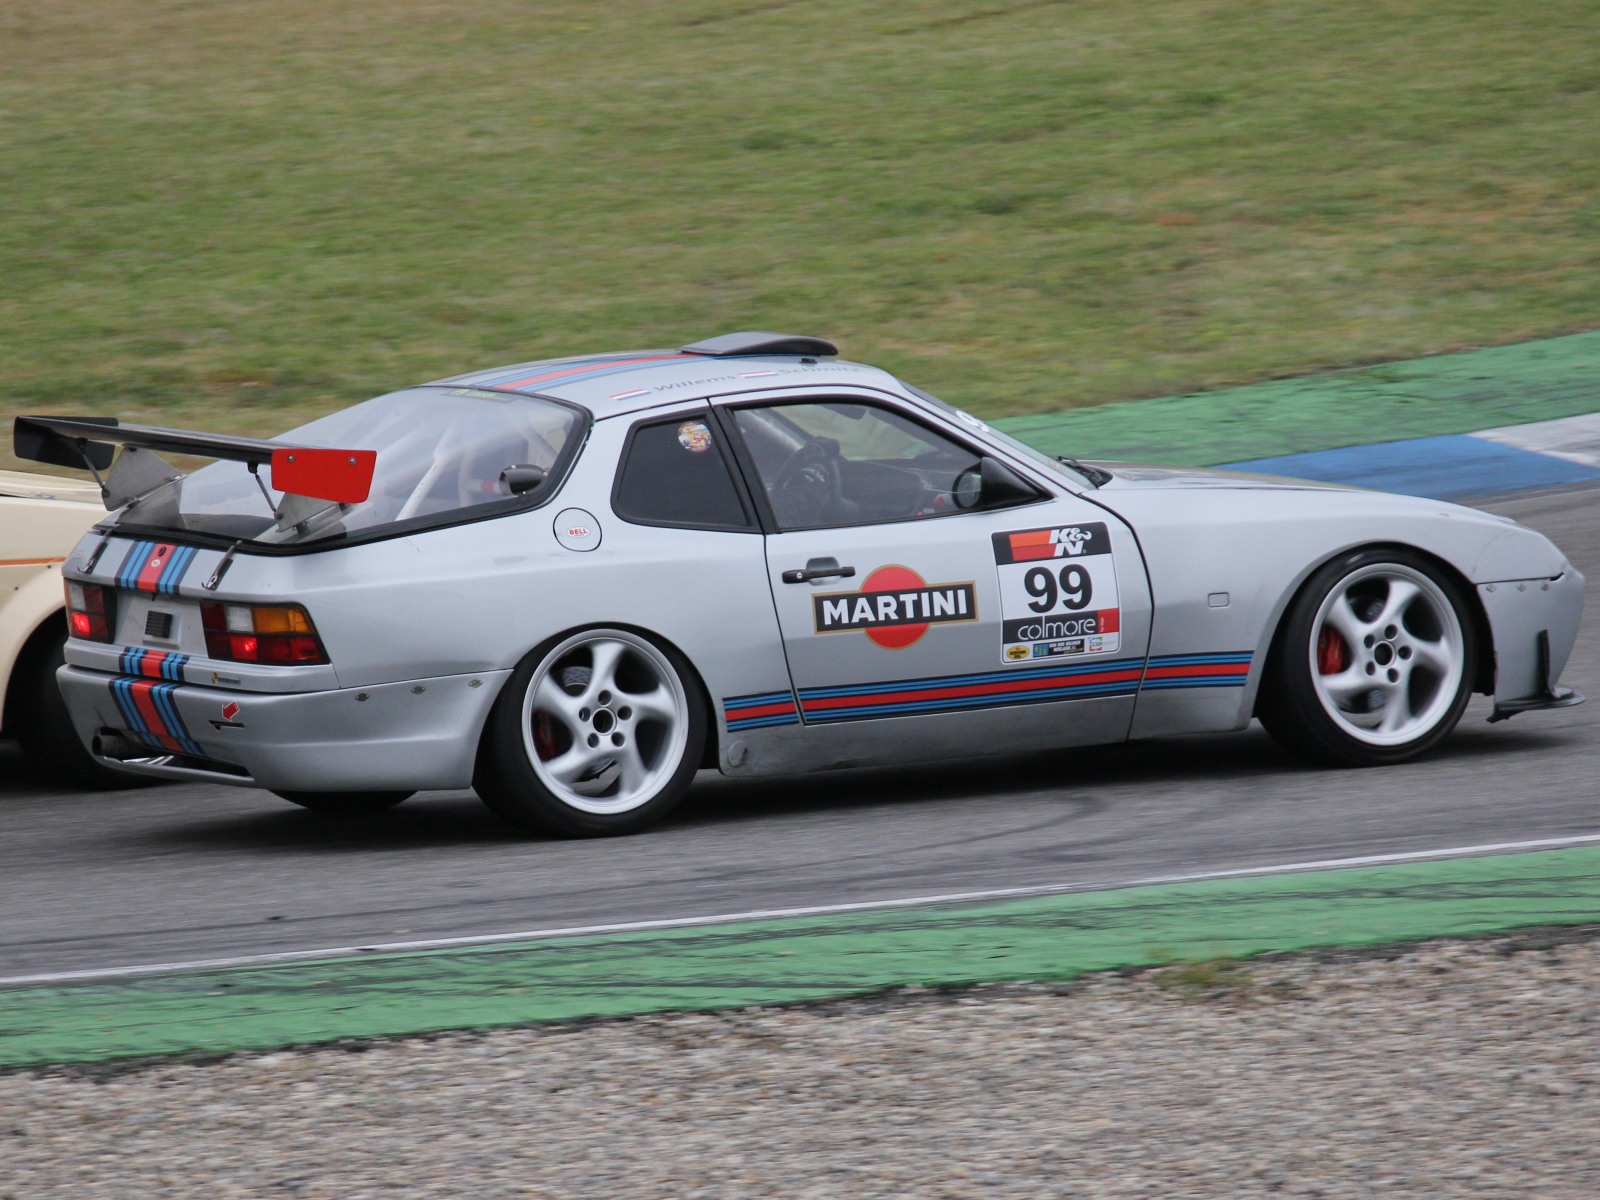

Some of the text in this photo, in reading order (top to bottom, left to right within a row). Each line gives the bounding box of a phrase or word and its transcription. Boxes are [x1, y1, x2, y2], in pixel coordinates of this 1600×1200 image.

[654, 374, 735, 391] Willems
[779, 366, 861, 375] Schmitz
[1024, 564, 1093, 613] 99
[823, 589, 968, 625] MARTINI
[1018, 615, 1096, 641] colmore
